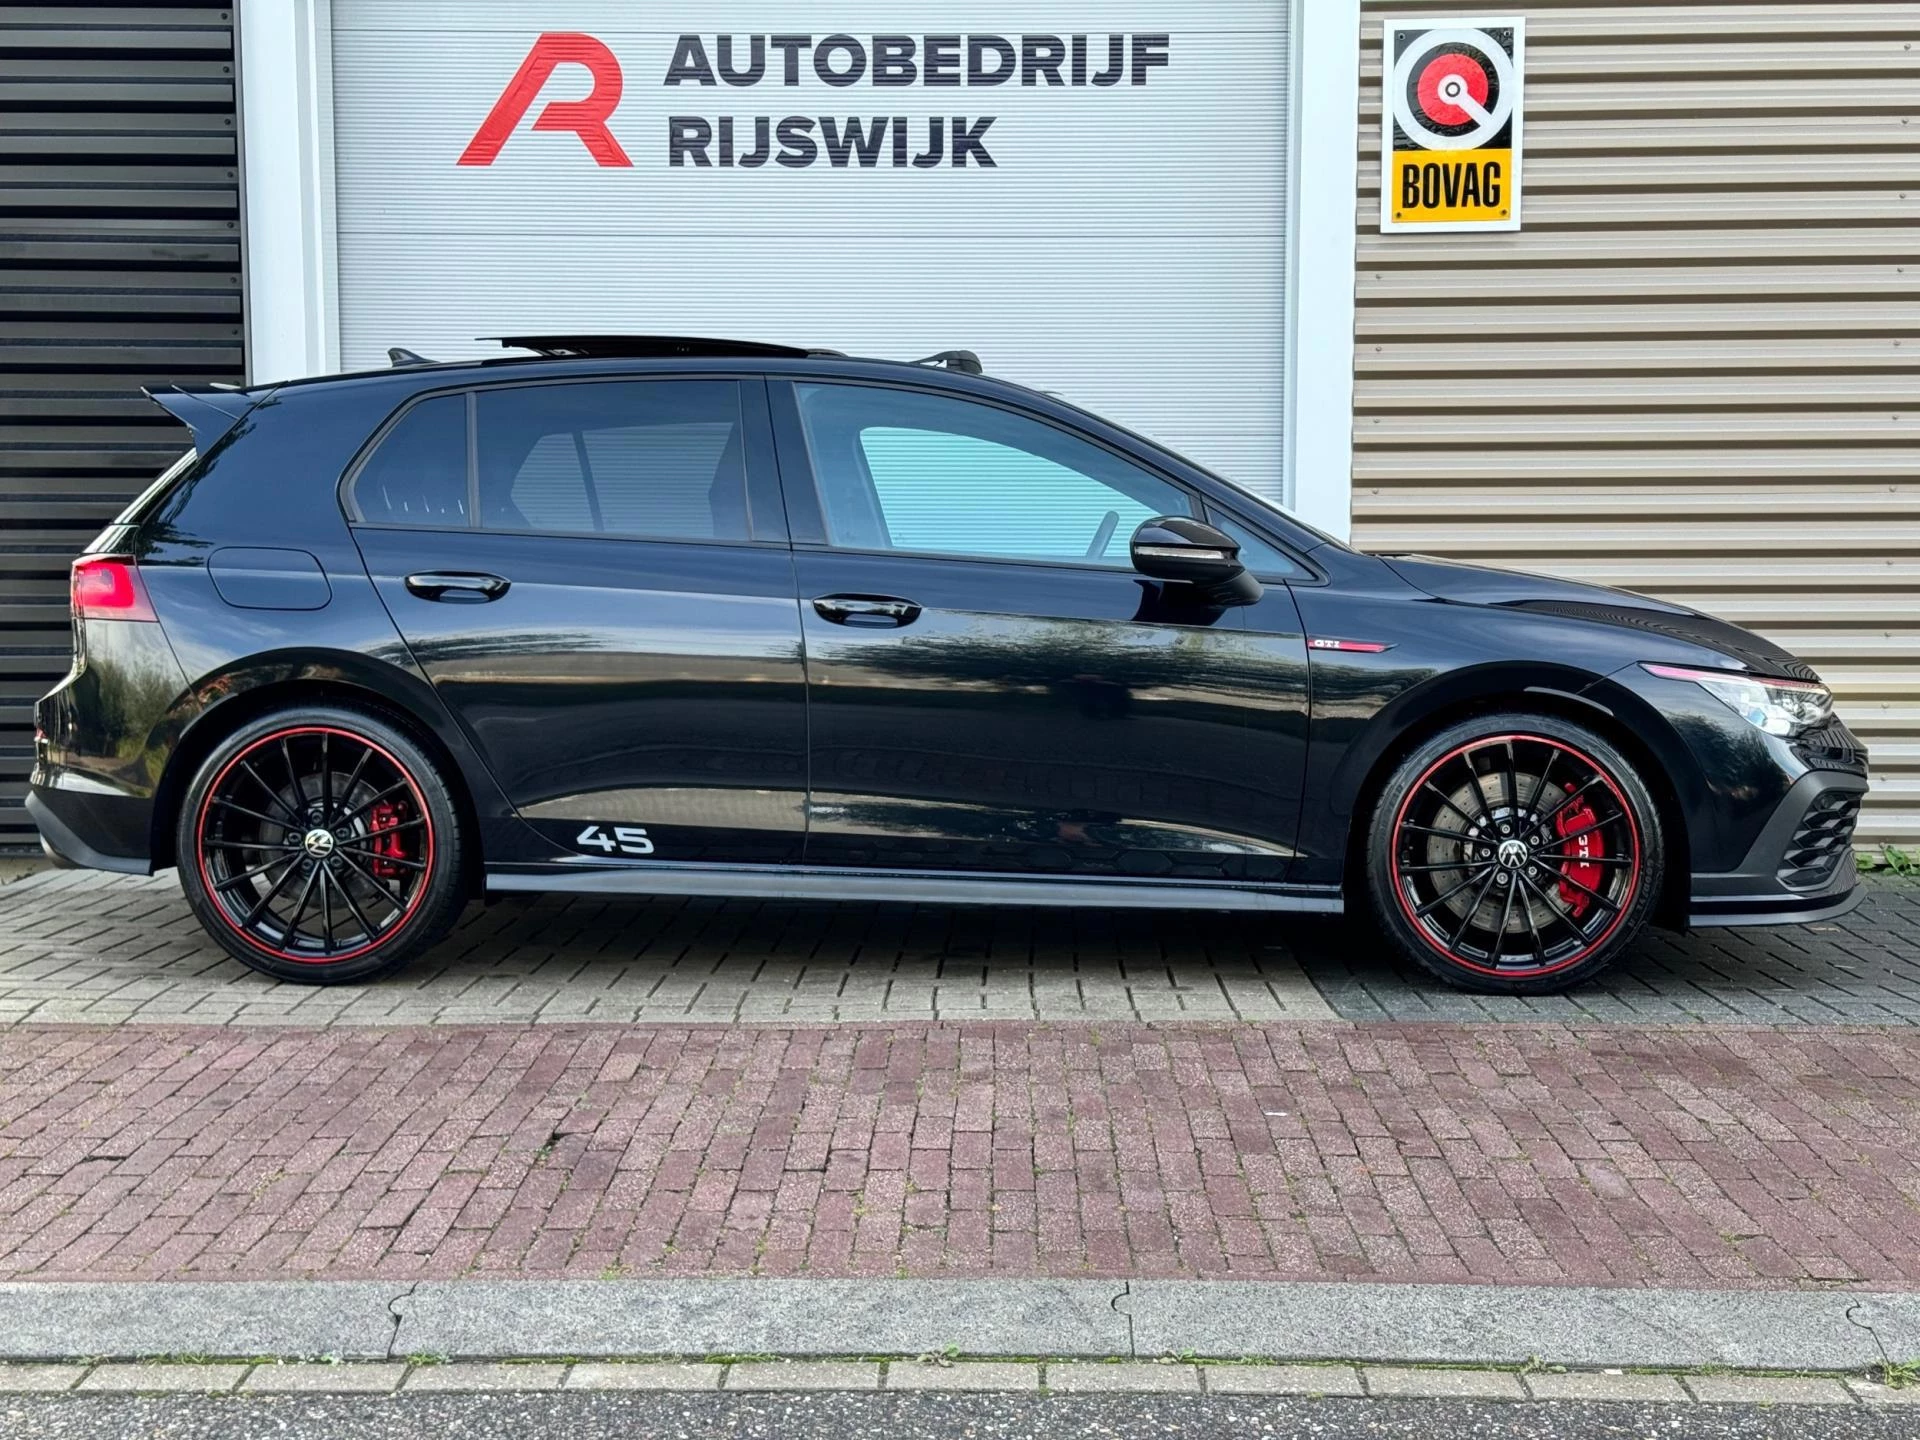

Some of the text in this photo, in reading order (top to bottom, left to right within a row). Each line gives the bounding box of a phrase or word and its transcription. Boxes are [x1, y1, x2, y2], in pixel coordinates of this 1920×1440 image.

[664, 34, 1169, 86] AUTOBEDRIJF
[669, 116, 998, 168] RIJSWIJK
[1402, 161, 1501, 209] BOVAG
[1314, 639, 1341, 649] GTI
[576, 825, 655, 854] 45
